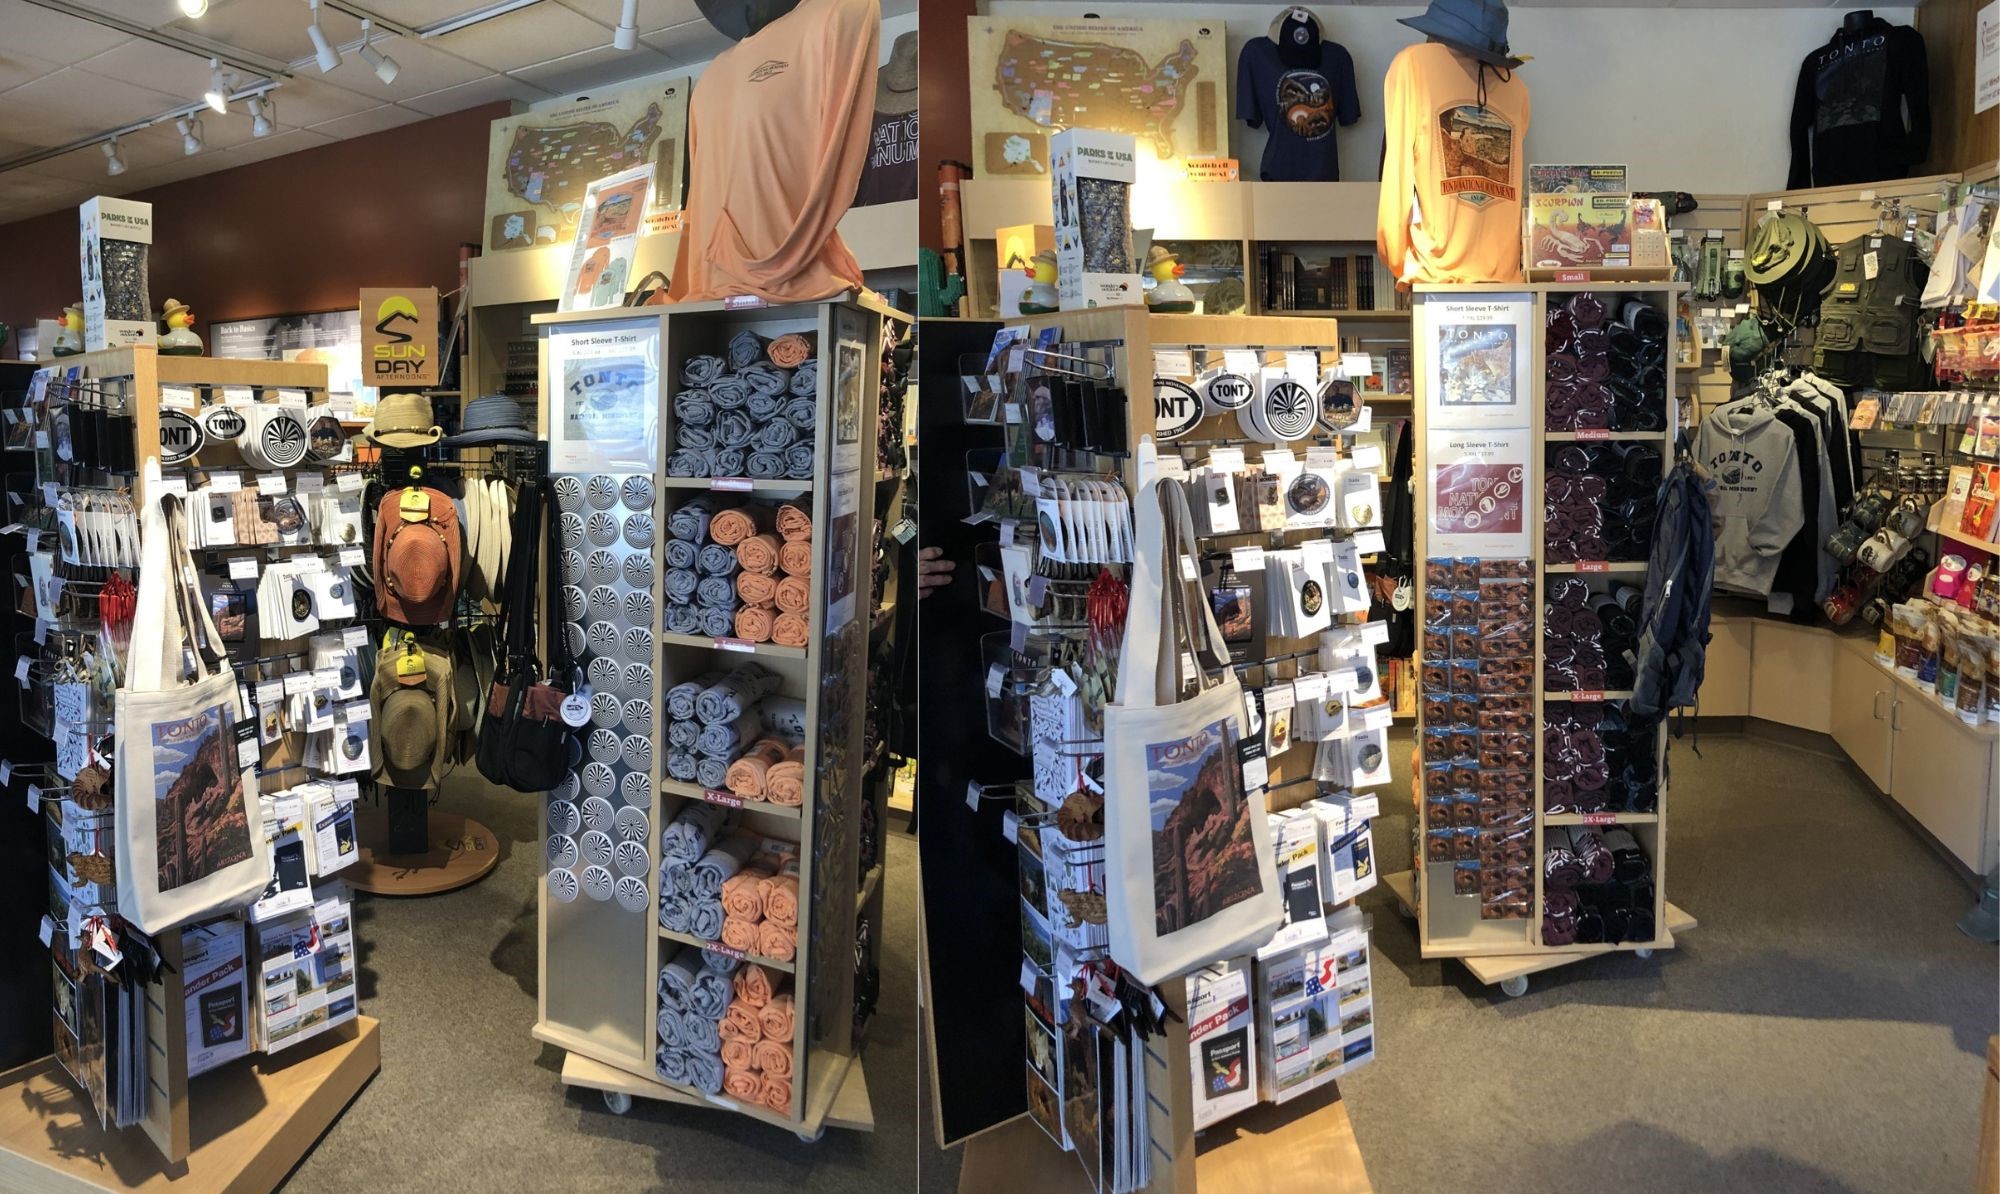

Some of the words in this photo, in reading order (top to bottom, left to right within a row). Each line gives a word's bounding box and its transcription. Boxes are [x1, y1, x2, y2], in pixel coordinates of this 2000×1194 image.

[1818, 35, 1885, 65] TONTO
[1077, 146, 1106, 158] PARKS
[1115, 151, 1133, 162] USA
[1535, 197, 1584, 208] SCORPION
[101, 212, 126, 223] PARKS
[134, 217, 149, 226] USA
[1562, 273, 1584, 281] Small
[221, 326, 232, 334] Back
[239, 325, 256, 333] Basics
[1447, 328, 1509, 341] TONTO
[591, 337, 613, 345] Sleeve
[614, 335, 637, 343] T-Shirt
[373, 344, 426, 358] SUN
[375, 360, 425, 374] DAY
[1215, 384, 1245, 397] TONT
[212, 418, 239, 430] TONT
[1577, 431, 1609, 439] Medium
[1710, 450, 1763, 473] TONTO
[1582, 564, 1602, 572] Large
[1572, 692, 1602, 701] X-Large
[157, 712, 208, 740] TONTO
[1152, 731, 1208, 763] TONTO
[707, 792, 741, 807] X-Large
[1584, 815, 1616, 824] 2X-Large
[216, 852, 247, 868] ARIZONA
[1291, 848, 1309, 862] Pack
[1222, 887, 1255, 905] ARIZONA
[706, 944, 745, 959] 2X-Large
[212, 964, 235, 980] Pack
[207, 996, 235, 1009] Passport
[1215, 1004, 1239, 1023] Pack
[1211, 1041, 1241, 1057] Passport
